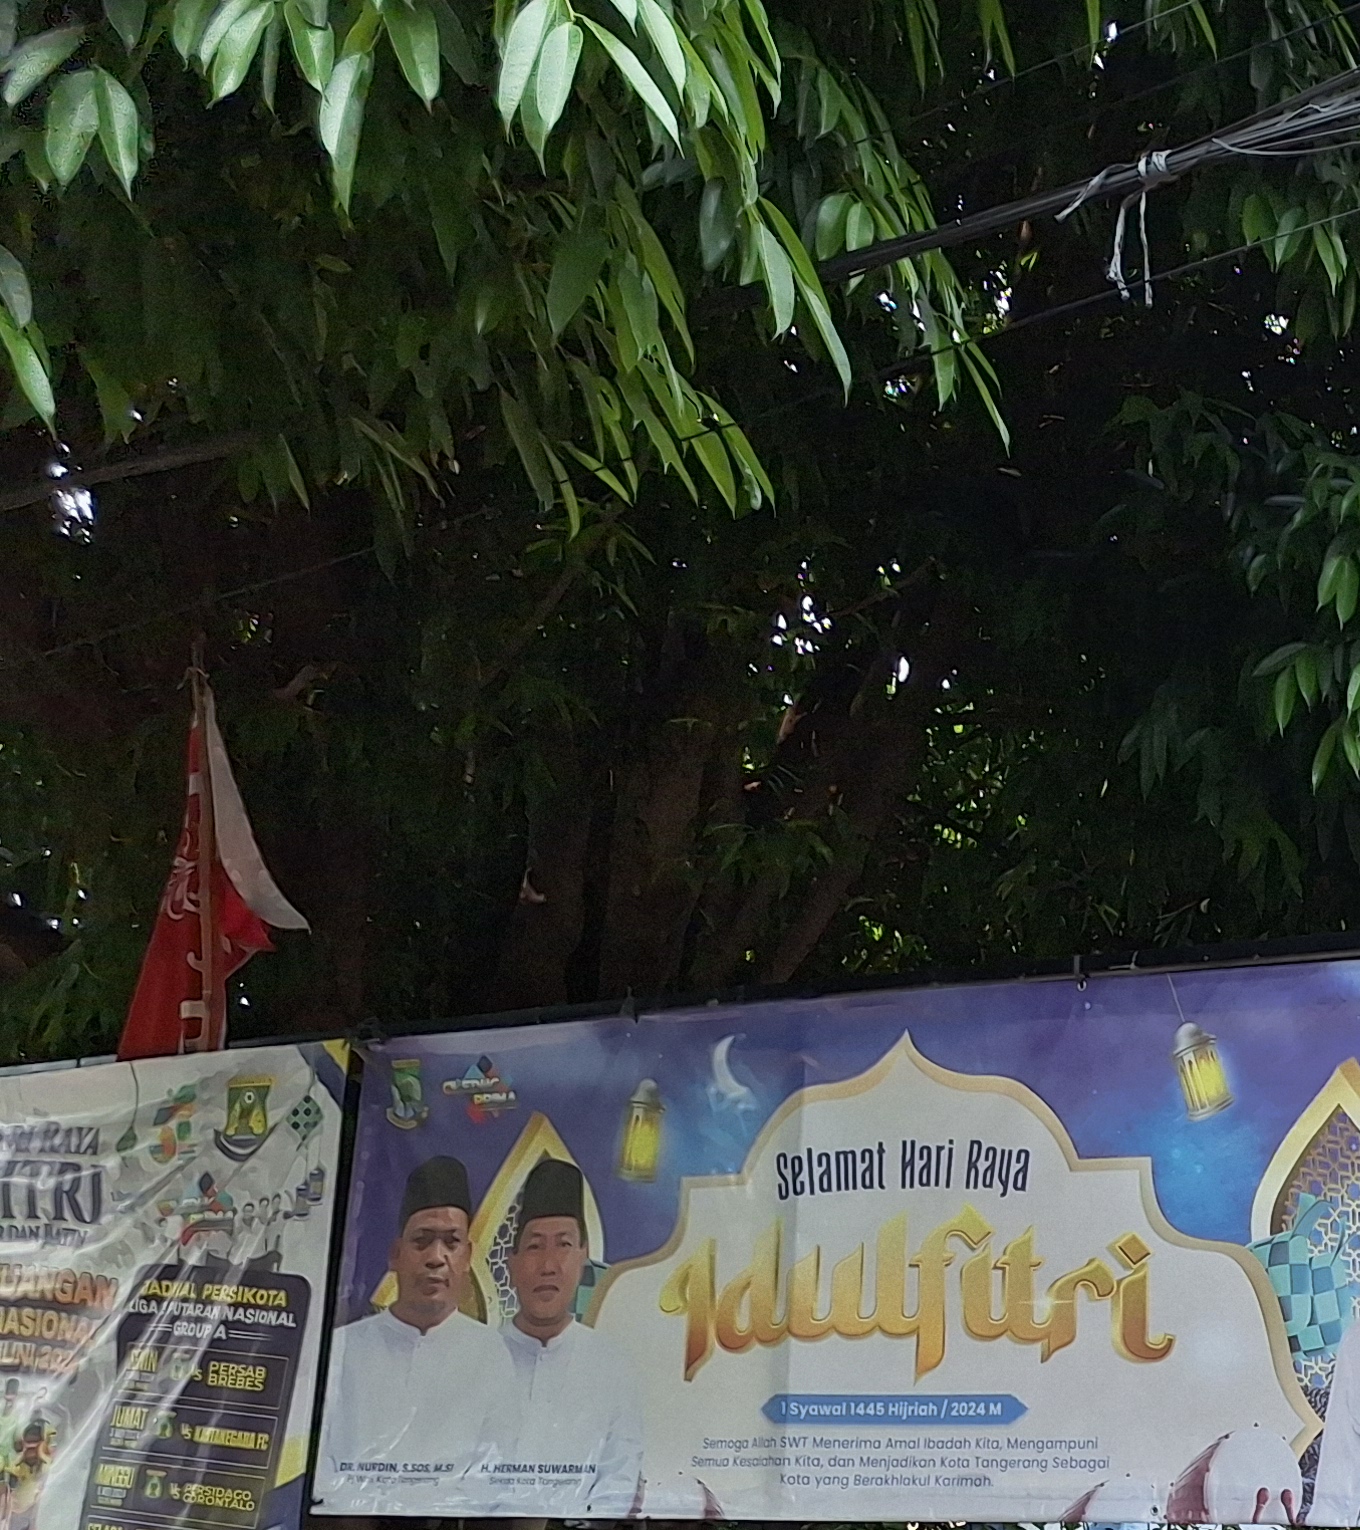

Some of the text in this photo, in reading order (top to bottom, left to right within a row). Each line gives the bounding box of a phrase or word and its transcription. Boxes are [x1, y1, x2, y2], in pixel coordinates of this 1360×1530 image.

[776, 1139, 1031, 1201] Selamat Hari Raya
[203, 1283, 288, 1307] PERSIKOTA
[659, 1202, 1175, 1384] Idulfitri
[222, 1306, 297, 1328] NASIONAL
[173, 1321, 227, 1340] GROUP A
[209, 1361, 267, 1379] PERSAB
[207, 1375, 264, 1392] BREBES
[789, 1402, 846, 1419] Syawal
[850, 1402, 885, 1416] 1445
[888, 1402, 937, 1420] Hijriah
[951, 1402, 986, 1416] 2024
[989, 1402, 1002, 1416] M
[702, 1436, 1098, 1453] Semoga Allah SWT Menerima Amal Ibadah Kita, Mengampuni
[493, 1464, 535, 1474] HERMAN
[537, 1464, 596, 1474] SUWARMAN
[691, 1455, 1110, 1473] Semua Kesalahan Kita, dan Menjadikan Kota Tangerang Sebagai
[780, 1473, 994, 1489] Kota yang Berakhlakul Karimah.
